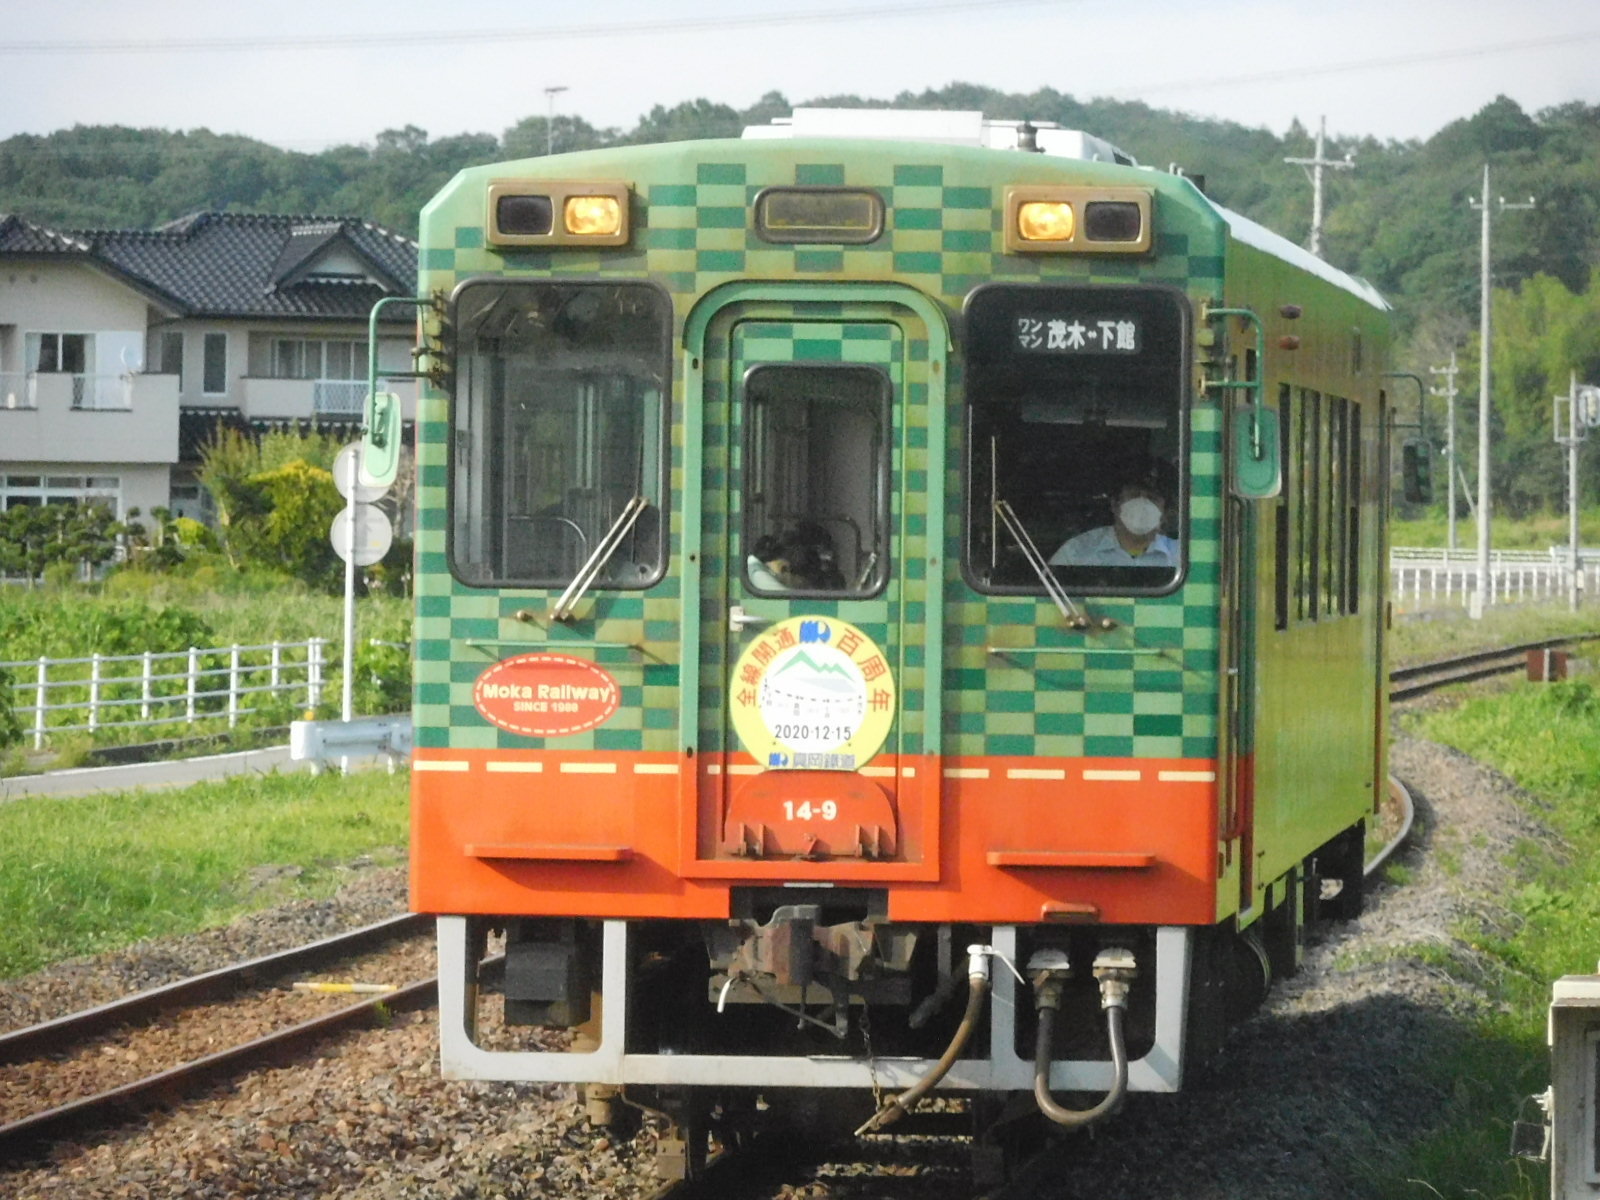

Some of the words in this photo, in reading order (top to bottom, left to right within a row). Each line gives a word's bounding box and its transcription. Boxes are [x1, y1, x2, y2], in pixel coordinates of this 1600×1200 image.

[482, 683, 533, 699] Moka
[537, 683, 610, 703] Railway
[513, 702, 548, 713] SINCE
[783, 800, 838, 821] 14-9
